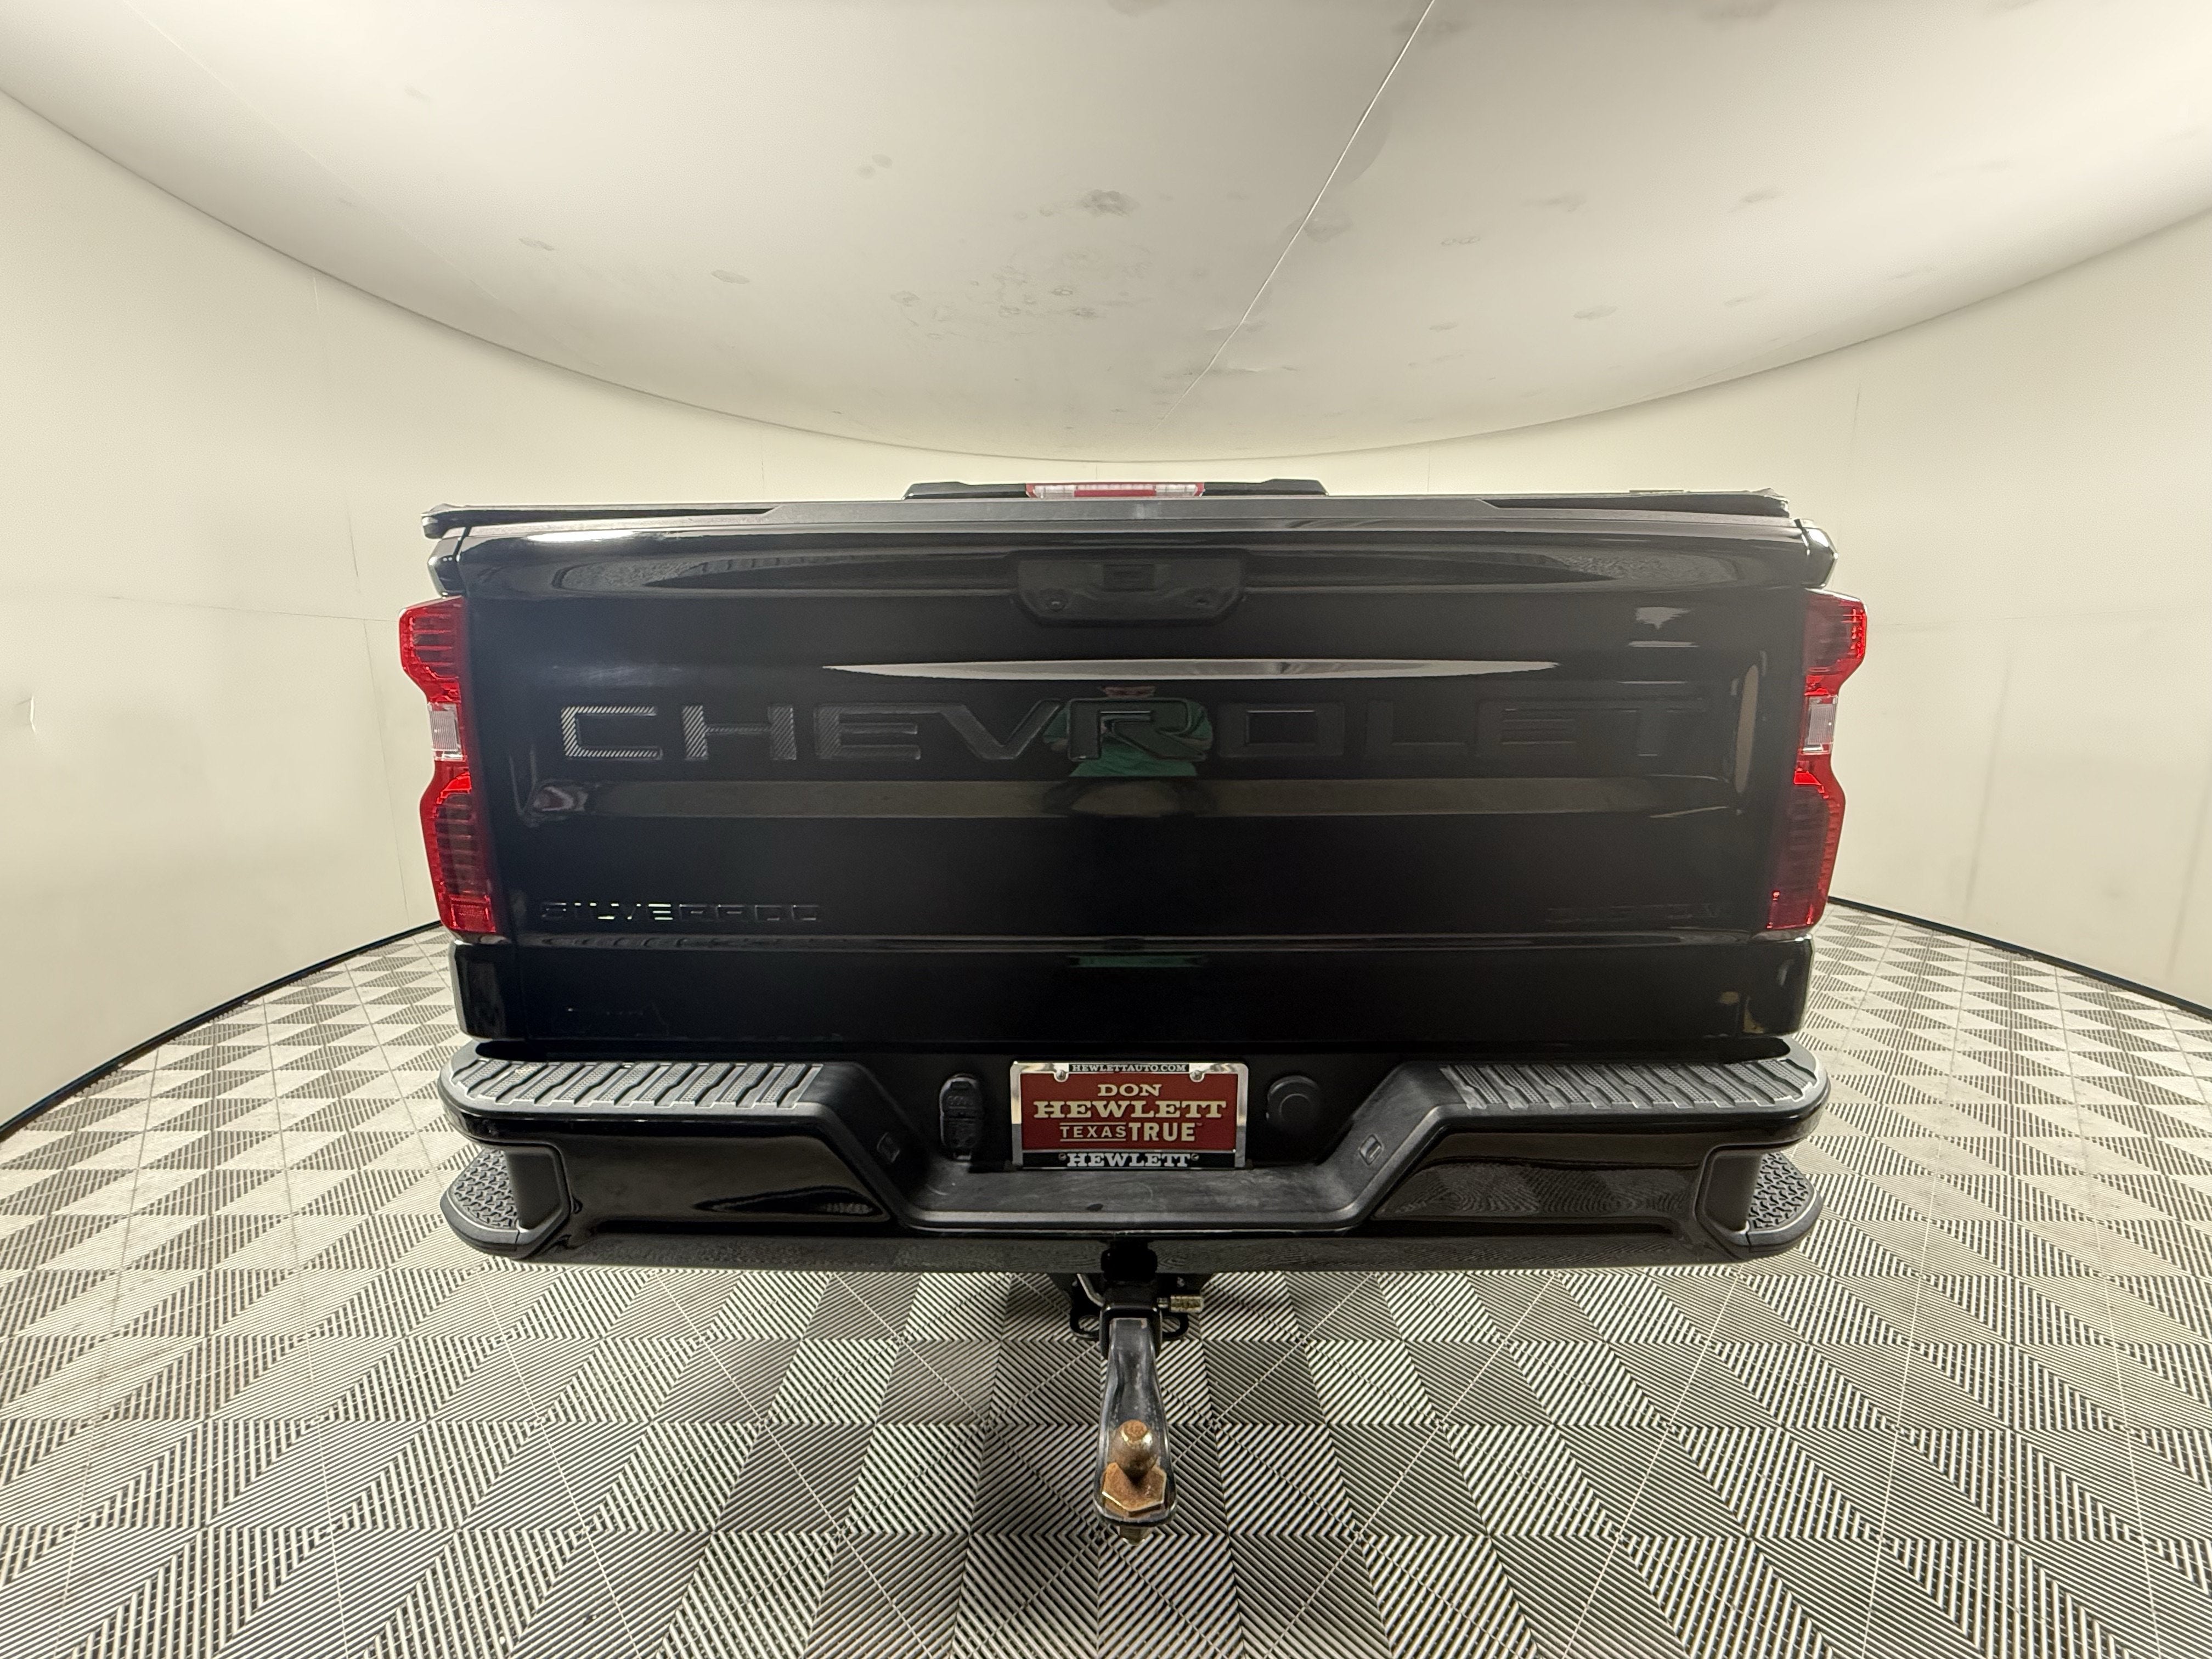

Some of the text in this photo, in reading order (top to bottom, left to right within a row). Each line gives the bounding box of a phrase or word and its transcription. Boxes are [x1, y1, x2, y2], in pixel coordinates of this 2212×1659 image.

[1071, 1064, 1187, 1073] HEWLETTAUTO.COM
[1097, 1083, 1163, 1097] DON
[1033, 1100, 1227, 1119] HEWLETT
[1066, 1153, 1191, 1167] HEWLETT
